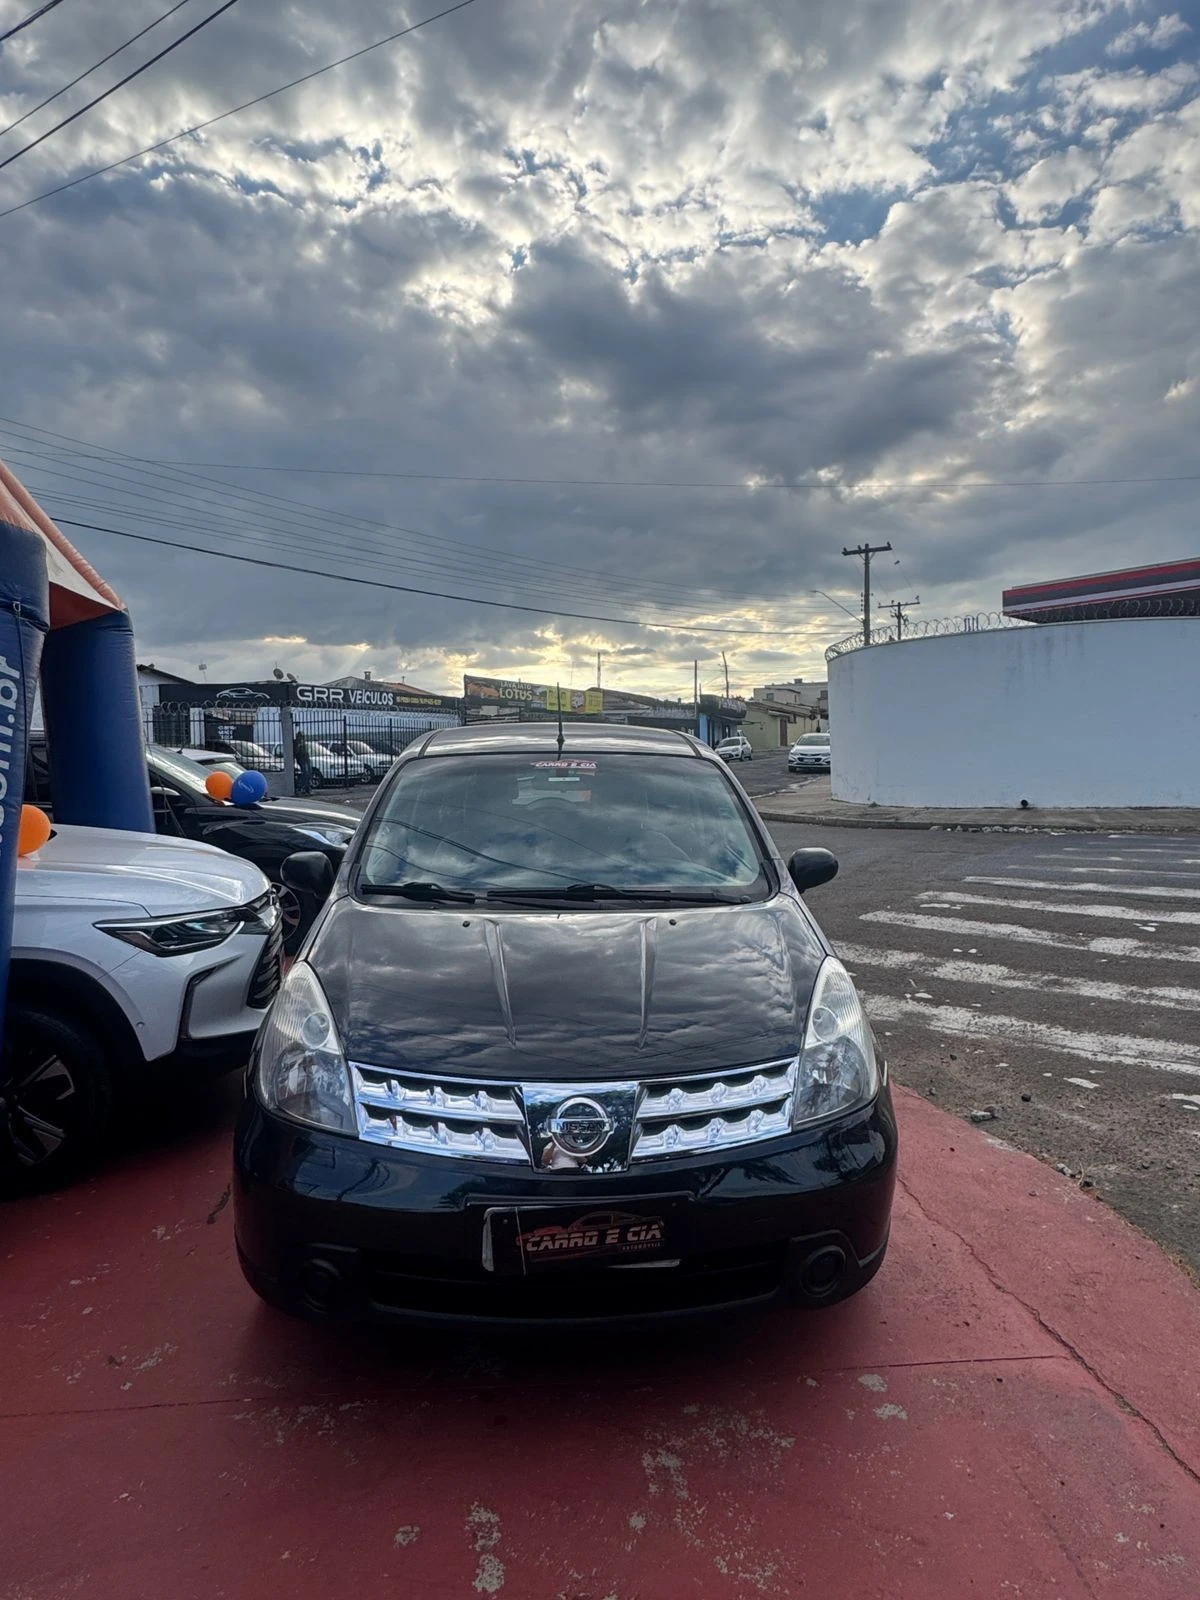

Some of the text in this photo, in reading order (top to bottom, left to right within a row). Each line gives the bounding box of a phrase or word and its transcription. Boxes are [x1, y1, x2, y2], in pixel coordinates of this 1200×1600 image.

[297, 686, 344, 702] GRR
[500, 688, 532, 701] LOTUS
[556, 1120, 604, 1131] NISSAN
[526, 1230, 599, 1252] CARRO
[605, 1229, 620, 1245] E
